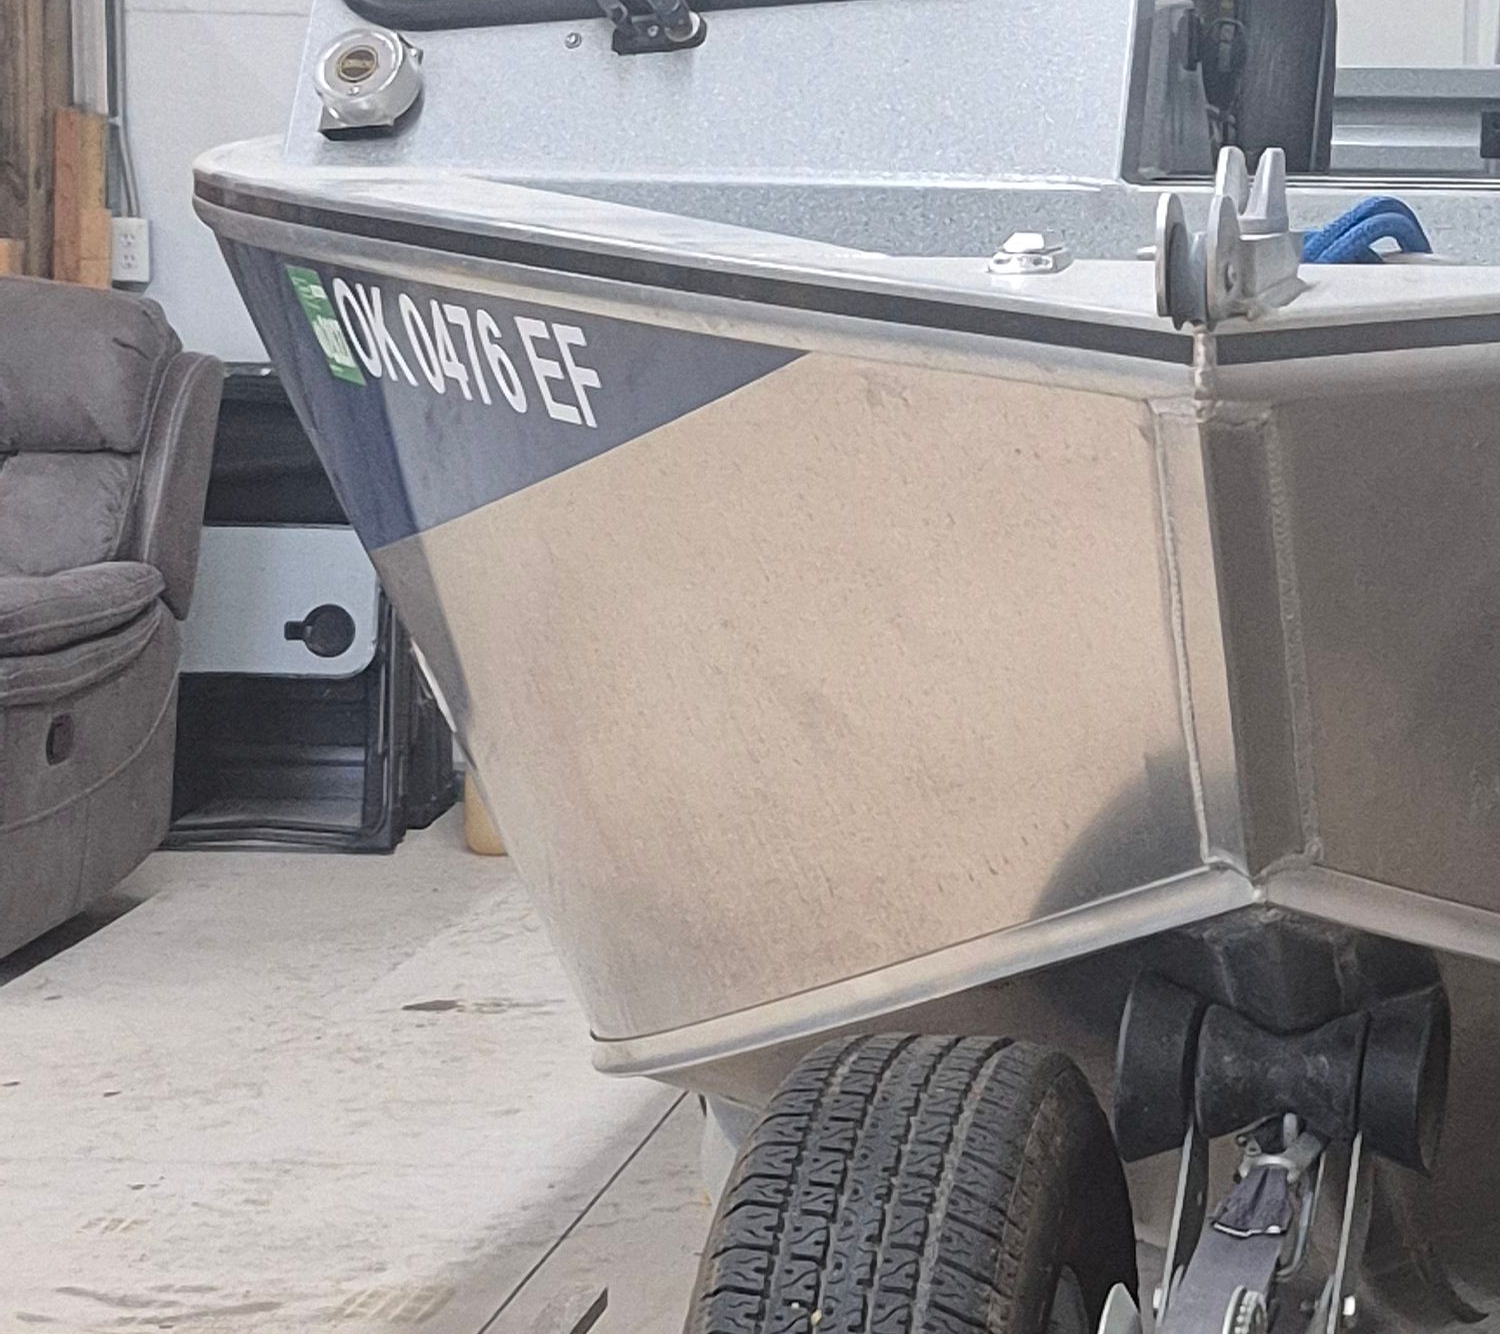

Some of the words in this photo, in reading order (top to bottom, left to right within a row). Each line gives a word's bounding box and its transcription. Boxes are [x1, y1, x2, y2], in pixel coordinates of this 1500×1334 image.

[332, 276, 419, 387] OK
[398, 292, 527, 414] 0476
[513, 315, 601, 429] EF
